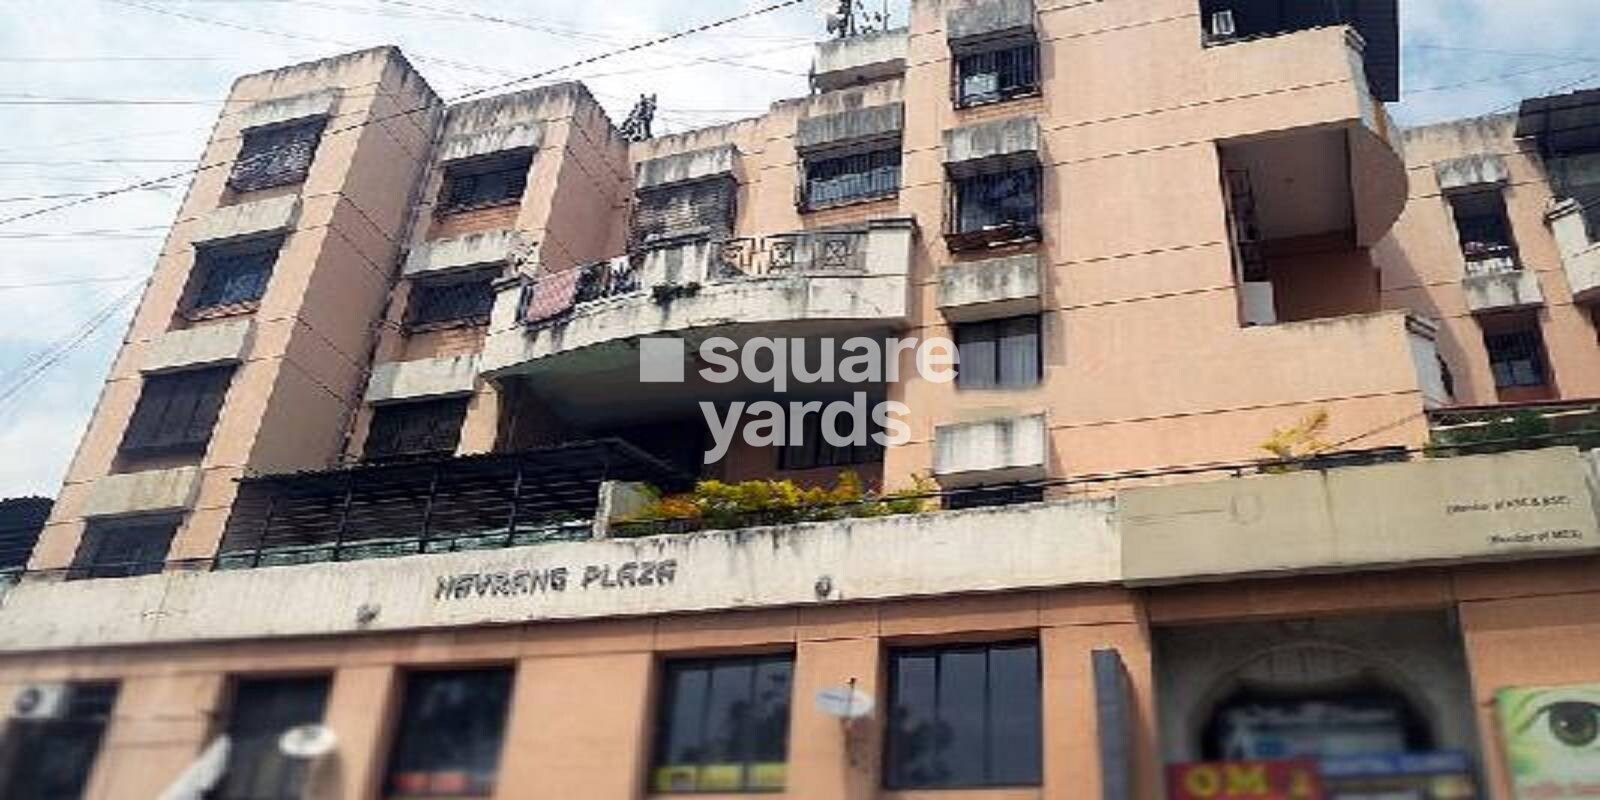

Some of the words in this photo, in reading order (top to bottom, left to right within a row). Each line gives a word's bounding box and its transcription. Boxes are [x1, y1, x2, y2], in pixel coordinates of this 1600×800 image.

[434, 566, 568, 601] NAVRANG
[581, 559, 678, 591] PLAZA
[1184, 766, 1269, 797] OM
